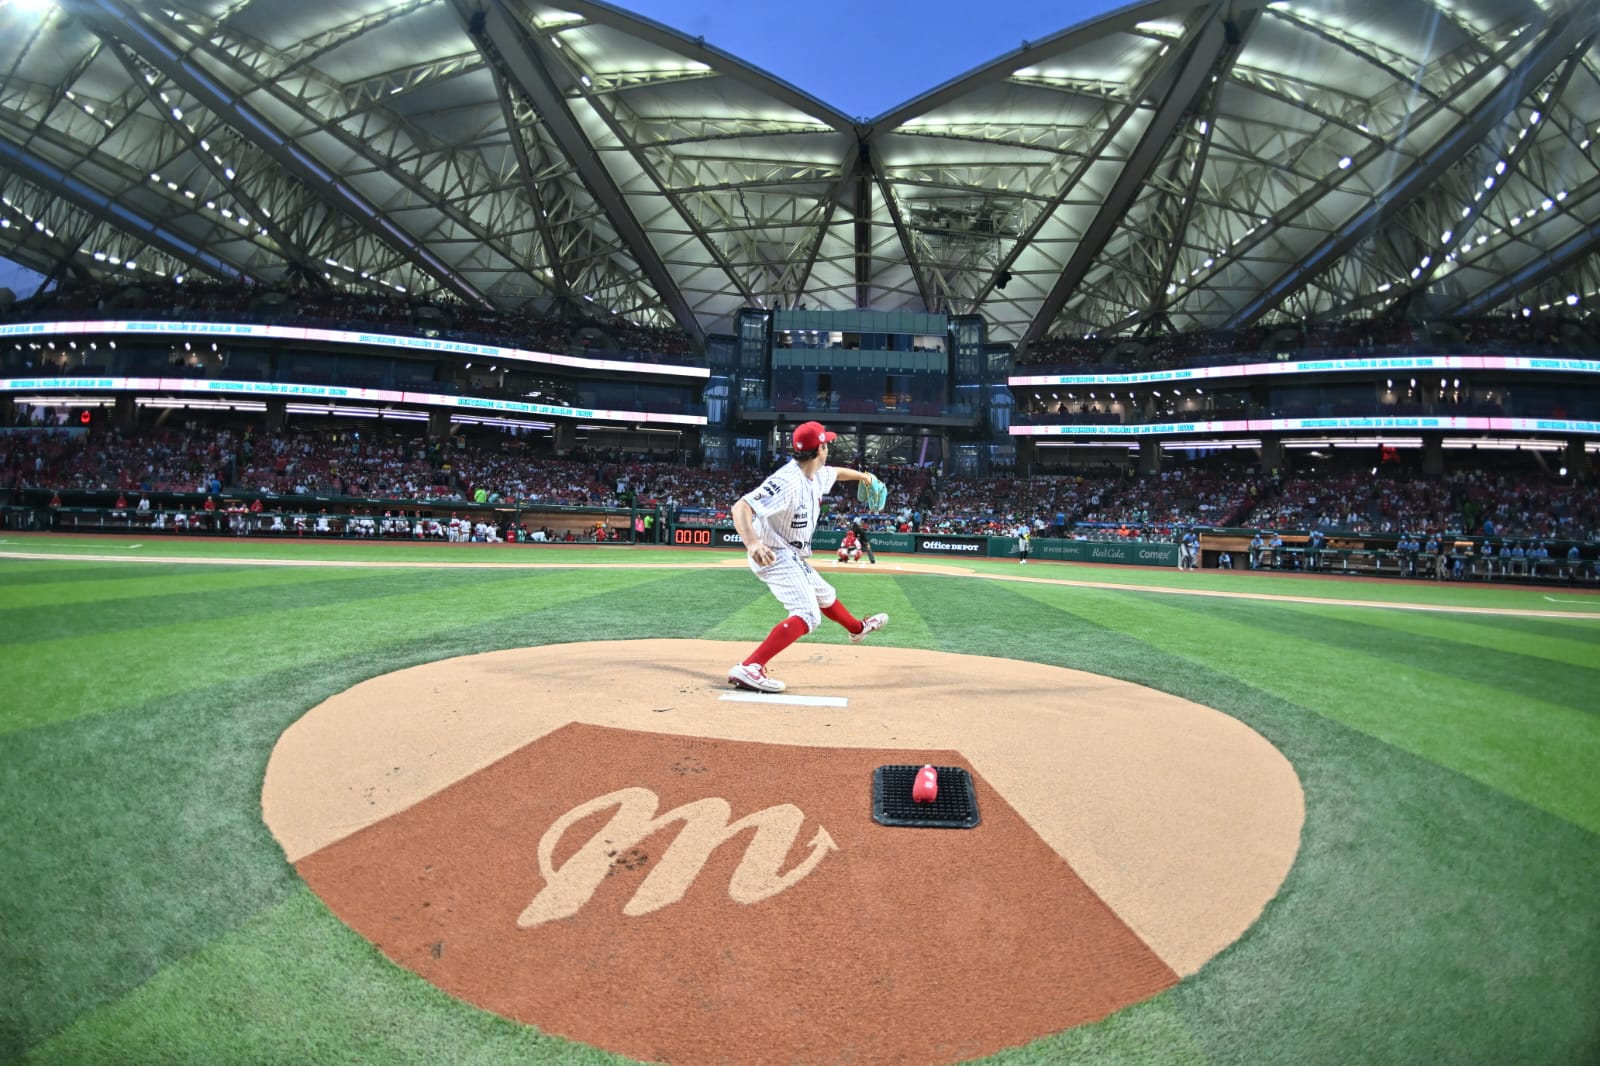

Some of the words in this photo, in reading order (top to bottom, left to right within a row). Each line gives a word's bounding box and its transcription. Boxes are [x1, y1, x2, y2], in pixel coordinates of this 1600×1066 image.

[723, 534, 743, 542] Offi
[922, 541, 950, 550] Office
[1139, 550, 1171, 560] Comex
